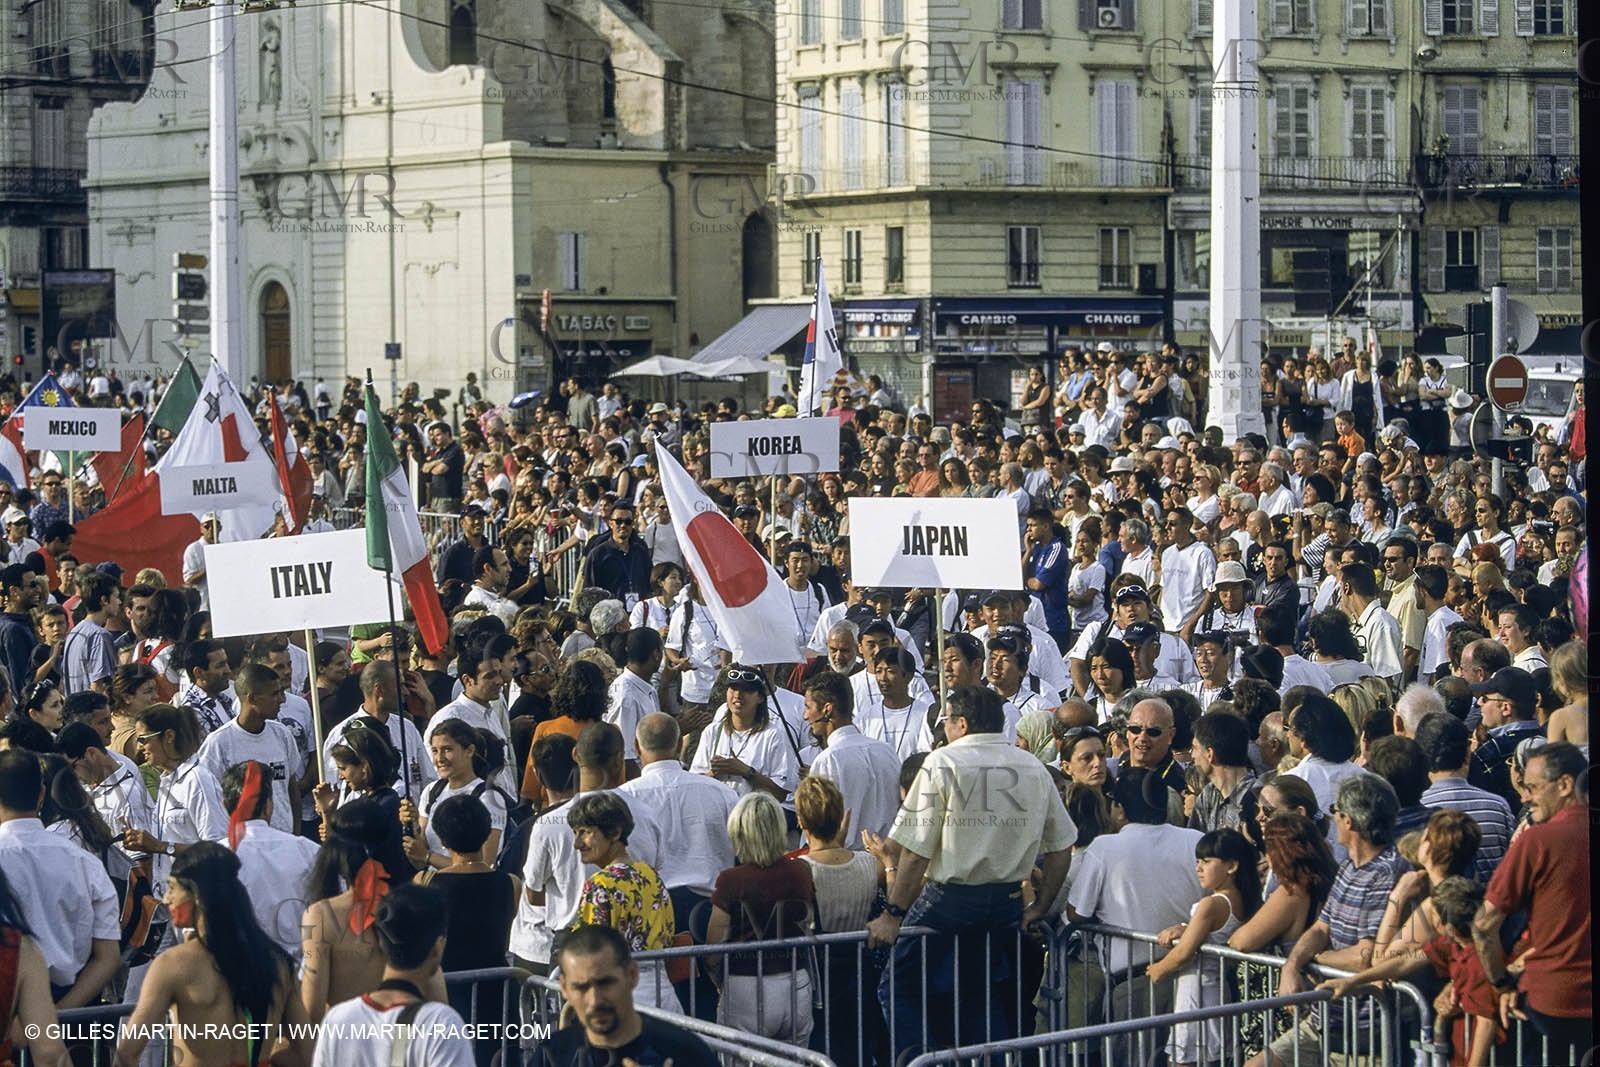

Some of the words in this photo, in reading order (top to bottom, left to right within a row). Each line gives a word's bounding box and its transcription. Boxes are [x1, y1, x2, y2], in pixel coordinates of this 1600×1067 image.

[1309, 215, 1353, 228] YVONNE
[559, 316, 616, 330] TABAC
[846, 313, 875, 322] CAMBIO
[882, 313, 913, 322] CHANGE
[961, 315, 1017, 324] CAMBIO
[1084, 314, 1141, 324] CHANGE
[48, 420, 97, 436] MEXICO
[747, 435, 802, 457] KOREA
[192, 476, 238, 495] MALTA
[902, 525, 968, 556] JAPAN
[270, 561, 333, 598] ITALY
